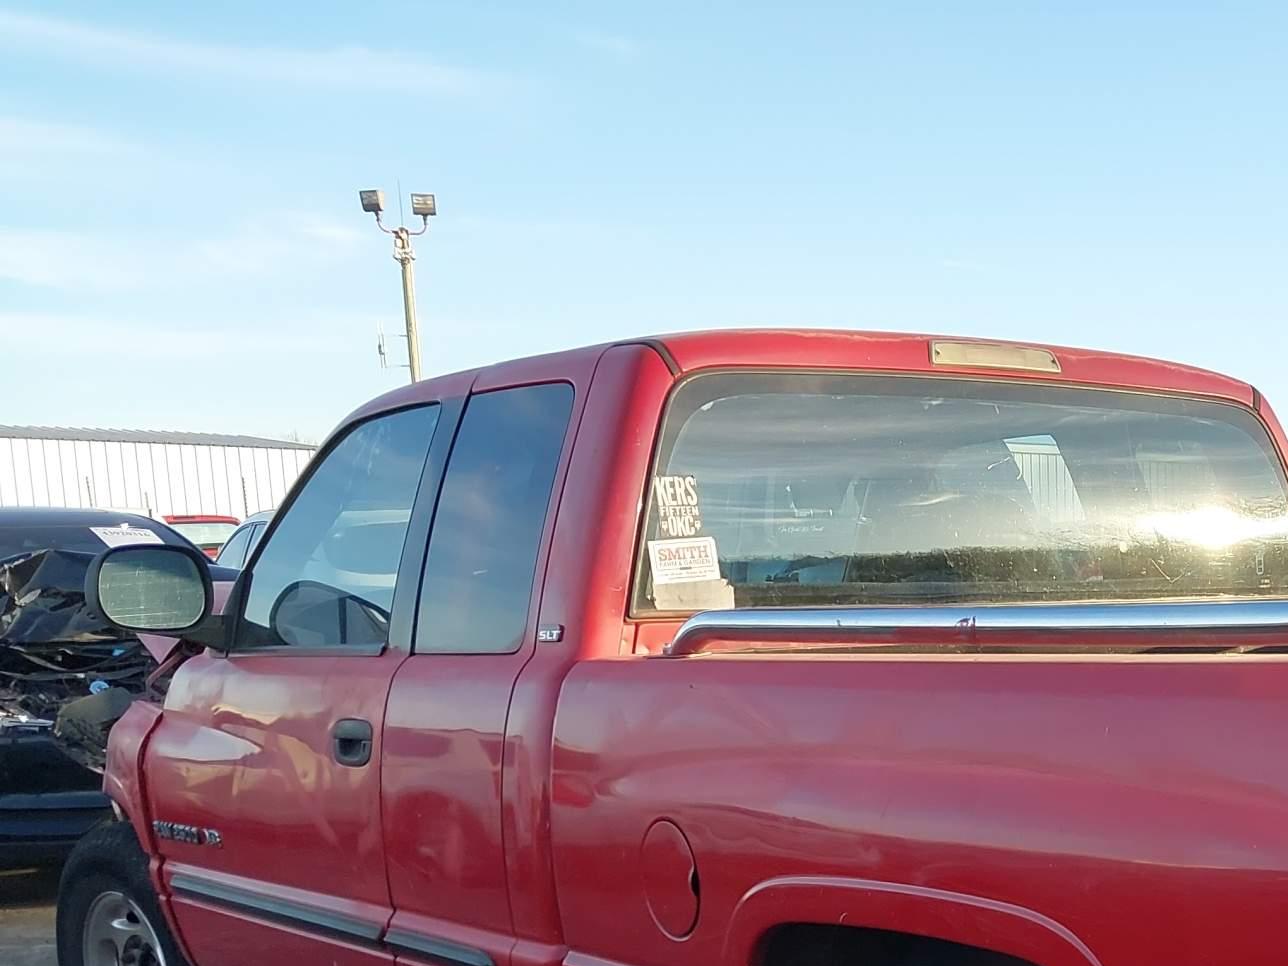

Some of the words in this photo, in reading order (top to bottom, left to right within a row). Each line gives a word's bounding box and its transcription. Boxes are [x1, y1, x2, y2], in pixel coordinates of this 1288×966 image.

[659, 505, 700, 517] FIFTEEN
[667, 516, 696, 536] OKC
[658, 544, 709, 561] SMITH
[538, 630, 561, 640] SLT
